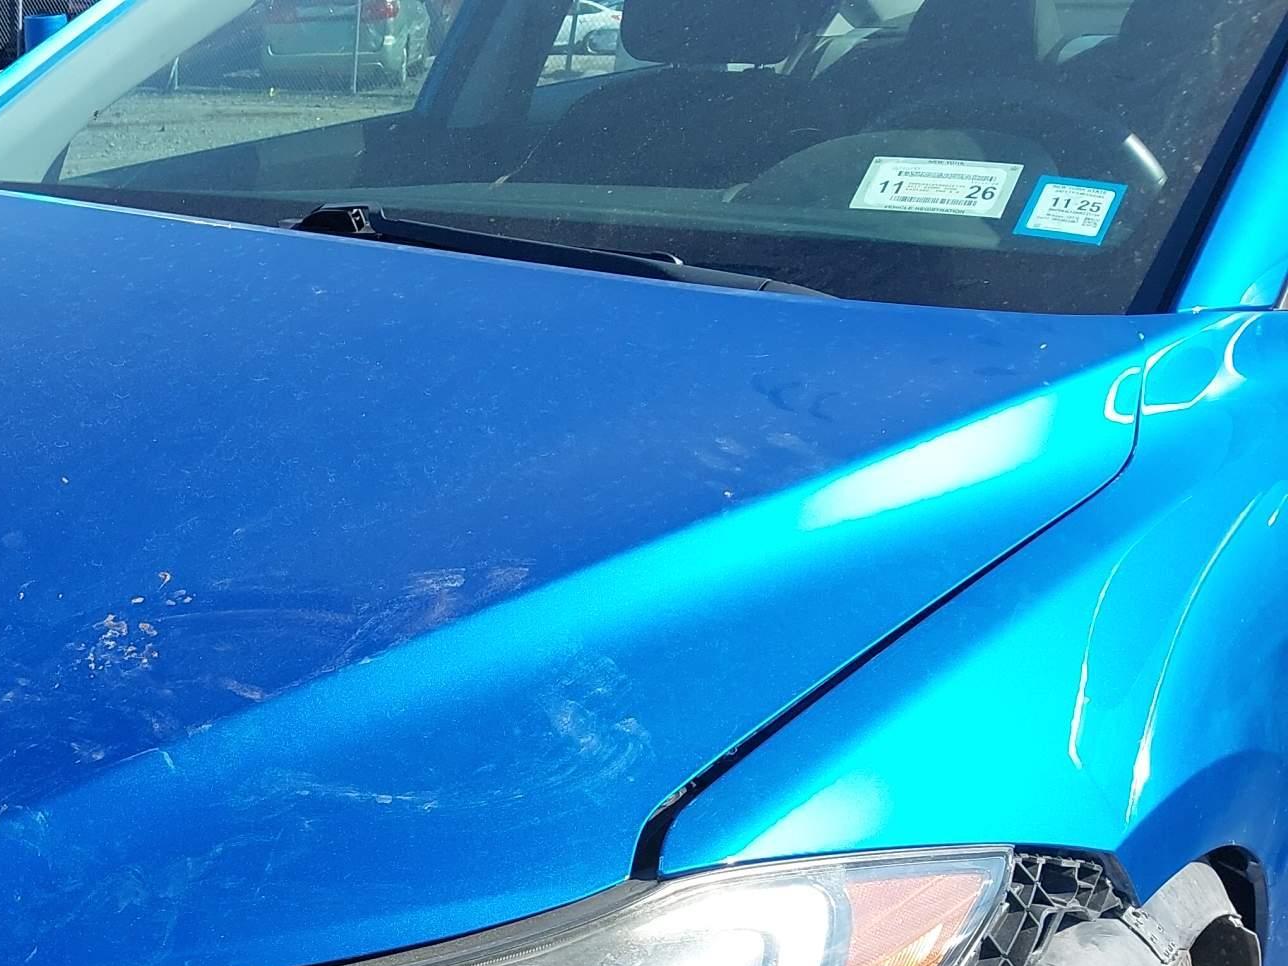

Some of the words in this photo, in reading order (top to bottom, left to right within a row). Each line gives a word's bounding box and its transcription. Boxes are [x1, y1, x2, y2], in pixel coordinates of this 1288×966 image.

[879, 180, 904, 195] 11
[965, 185, 998, 201] 26
[1052, 197, 1071, 209] 11
[1077, 199, 1103, 213] 25
